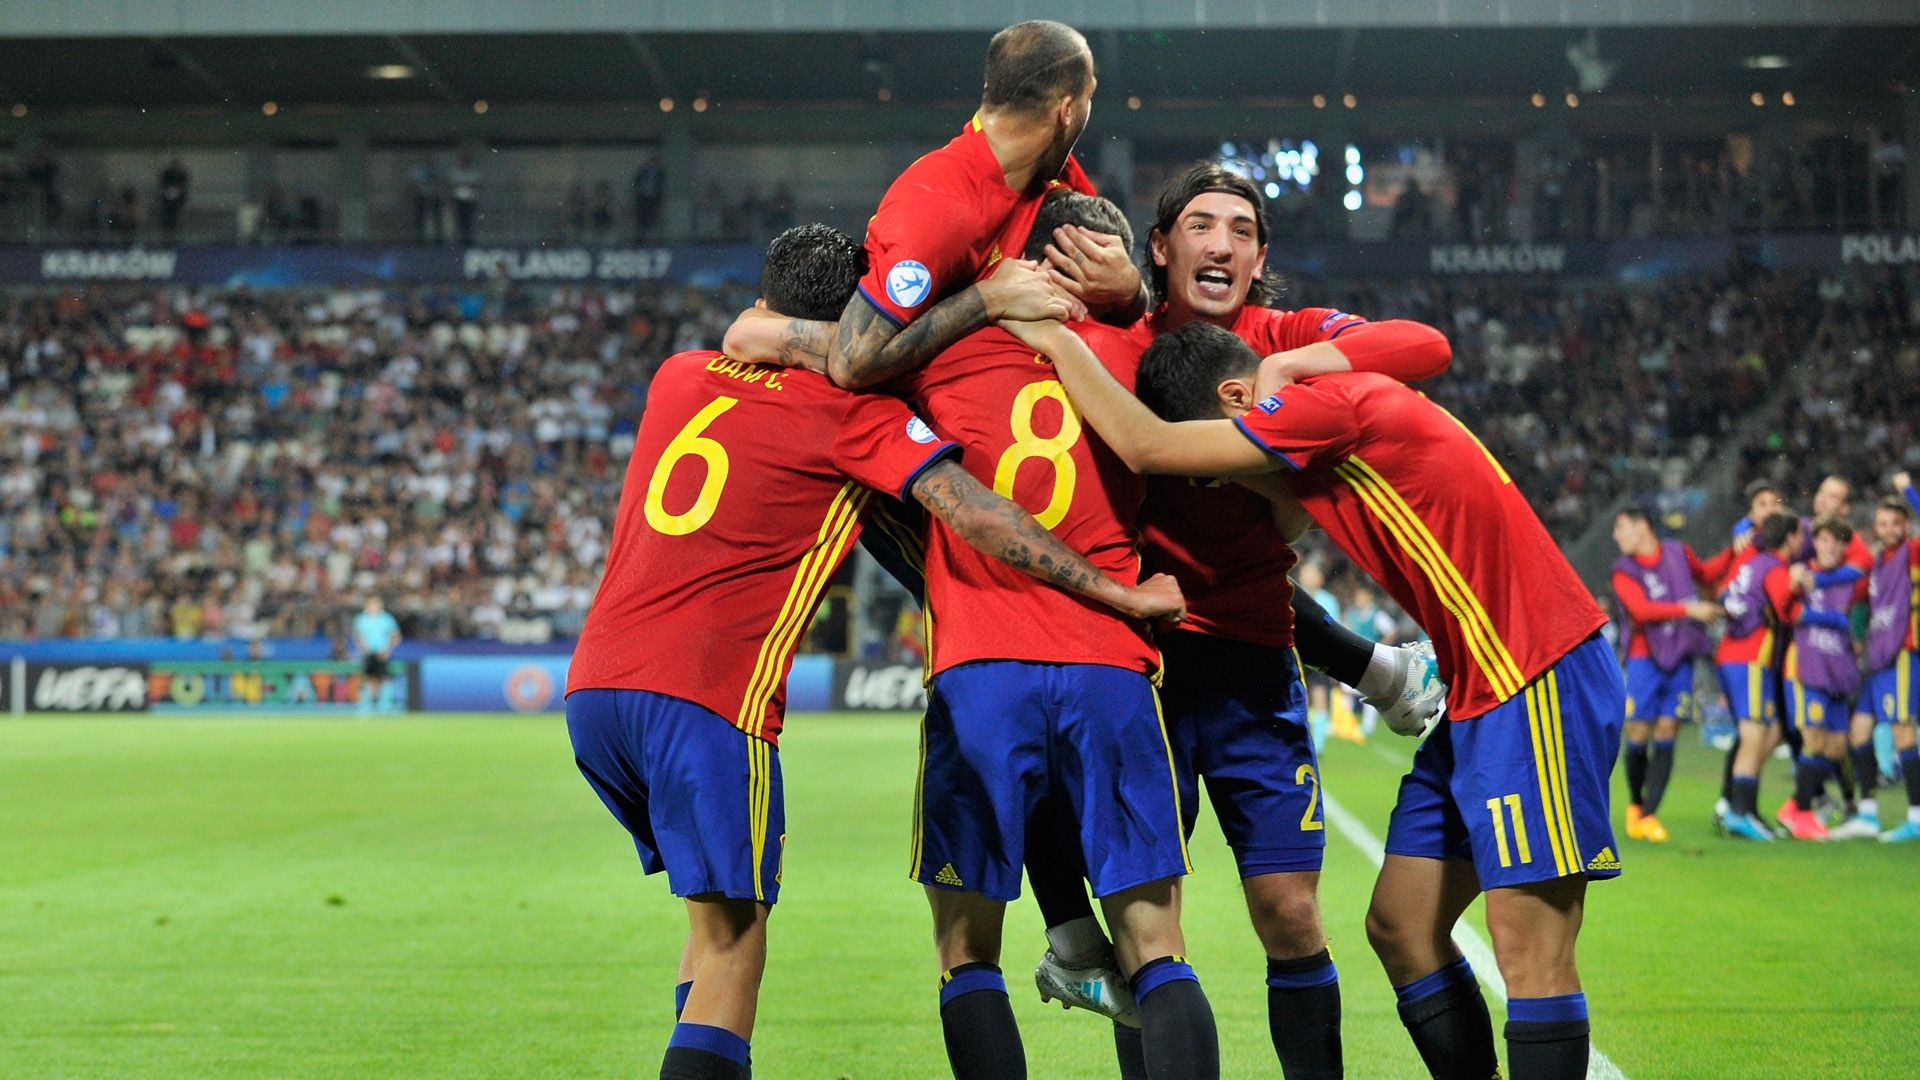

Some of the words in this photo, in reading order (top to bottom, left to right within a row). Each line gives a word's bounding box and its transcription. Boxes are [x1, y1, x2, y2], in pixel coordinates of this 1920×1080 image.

[465, 250, 592, 280] POLAND
[597, 250, 672, 279] 2017
[644, 395, 739, 536] 6
[993, 379, 1082, 531] 8
[34, 666, 146, 711] UEFA
[844, 665, 928, 710] UEF
[1295, 763, 1324, 832] 2
[1486, 793, 1533, 868] 11
